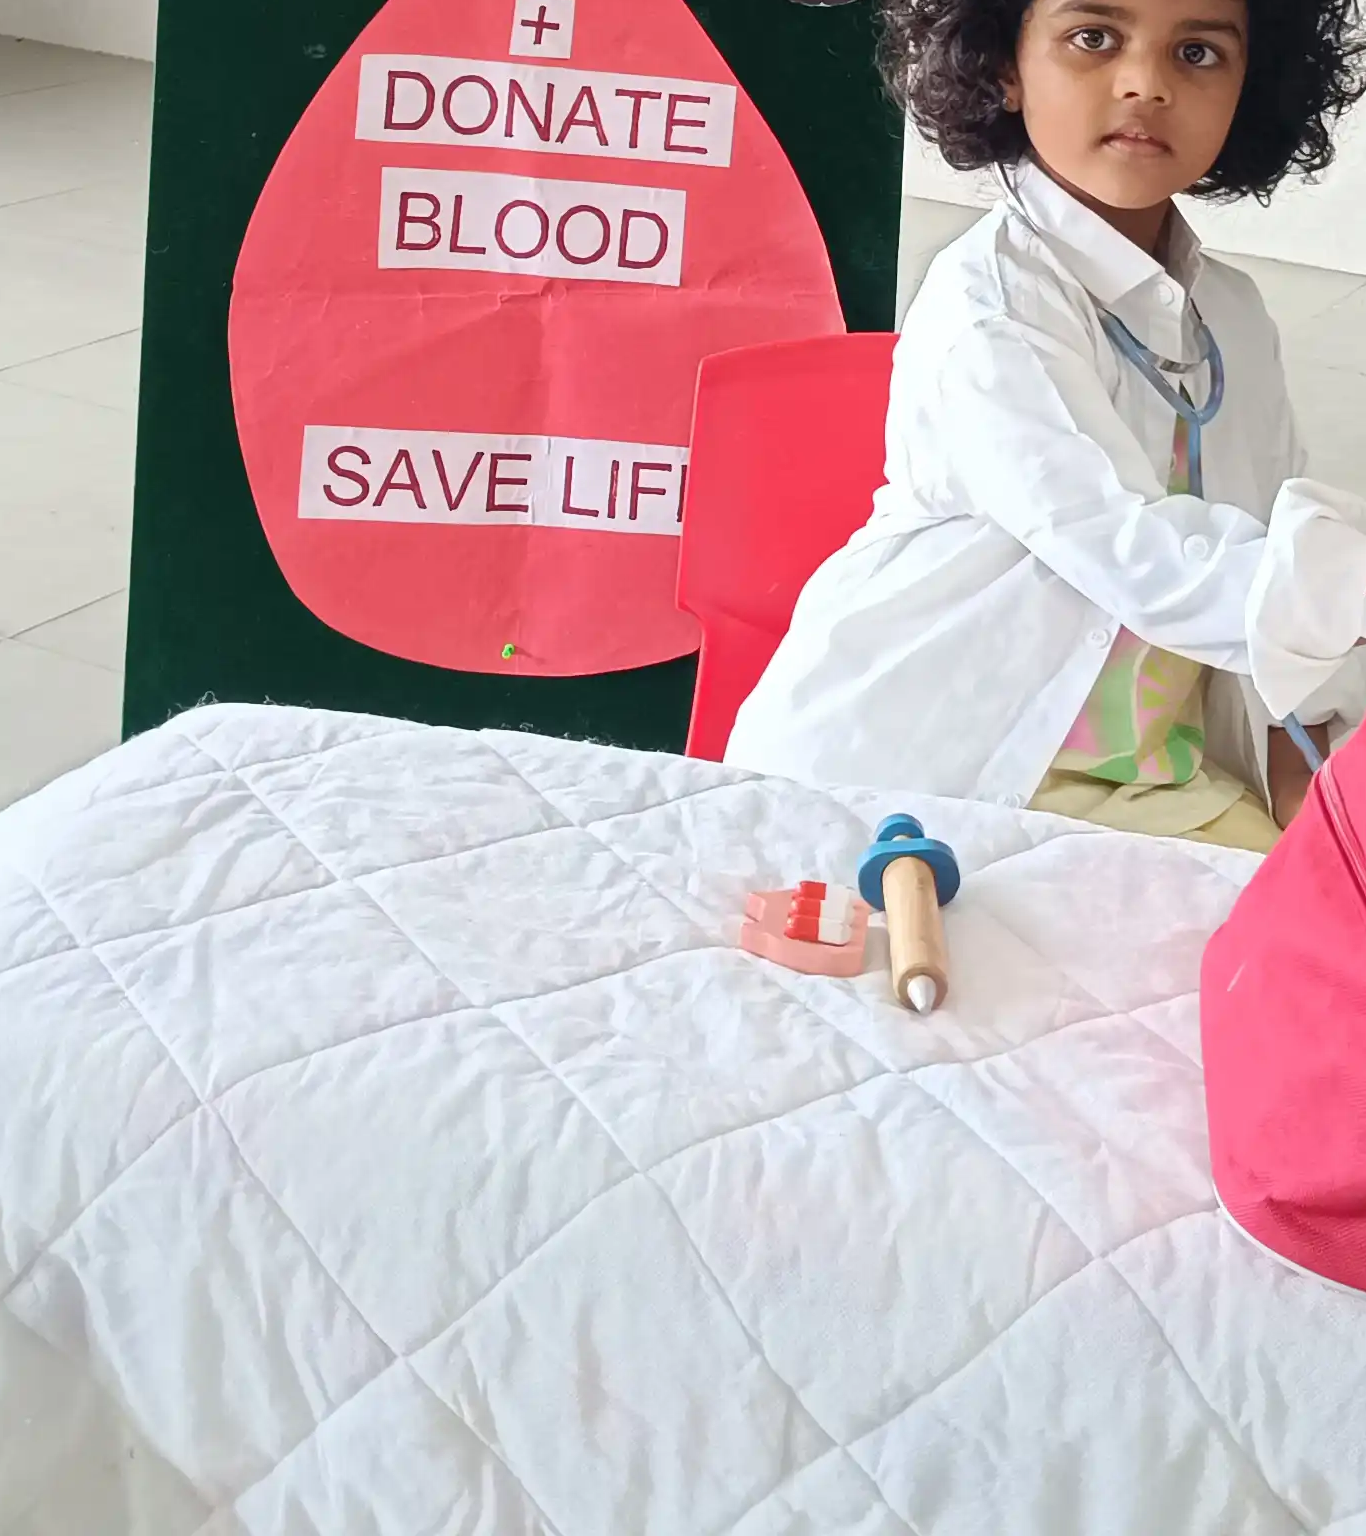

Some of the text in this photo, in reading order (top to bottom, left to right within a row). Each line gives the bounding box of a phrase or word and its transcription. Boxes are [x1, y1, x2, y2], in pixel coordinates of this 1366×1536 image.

[383, 70, 711, 154] DONATE
[395, 191, 669, 270] BLOOD
[322, 445, 688, 523] SAVE LIF
